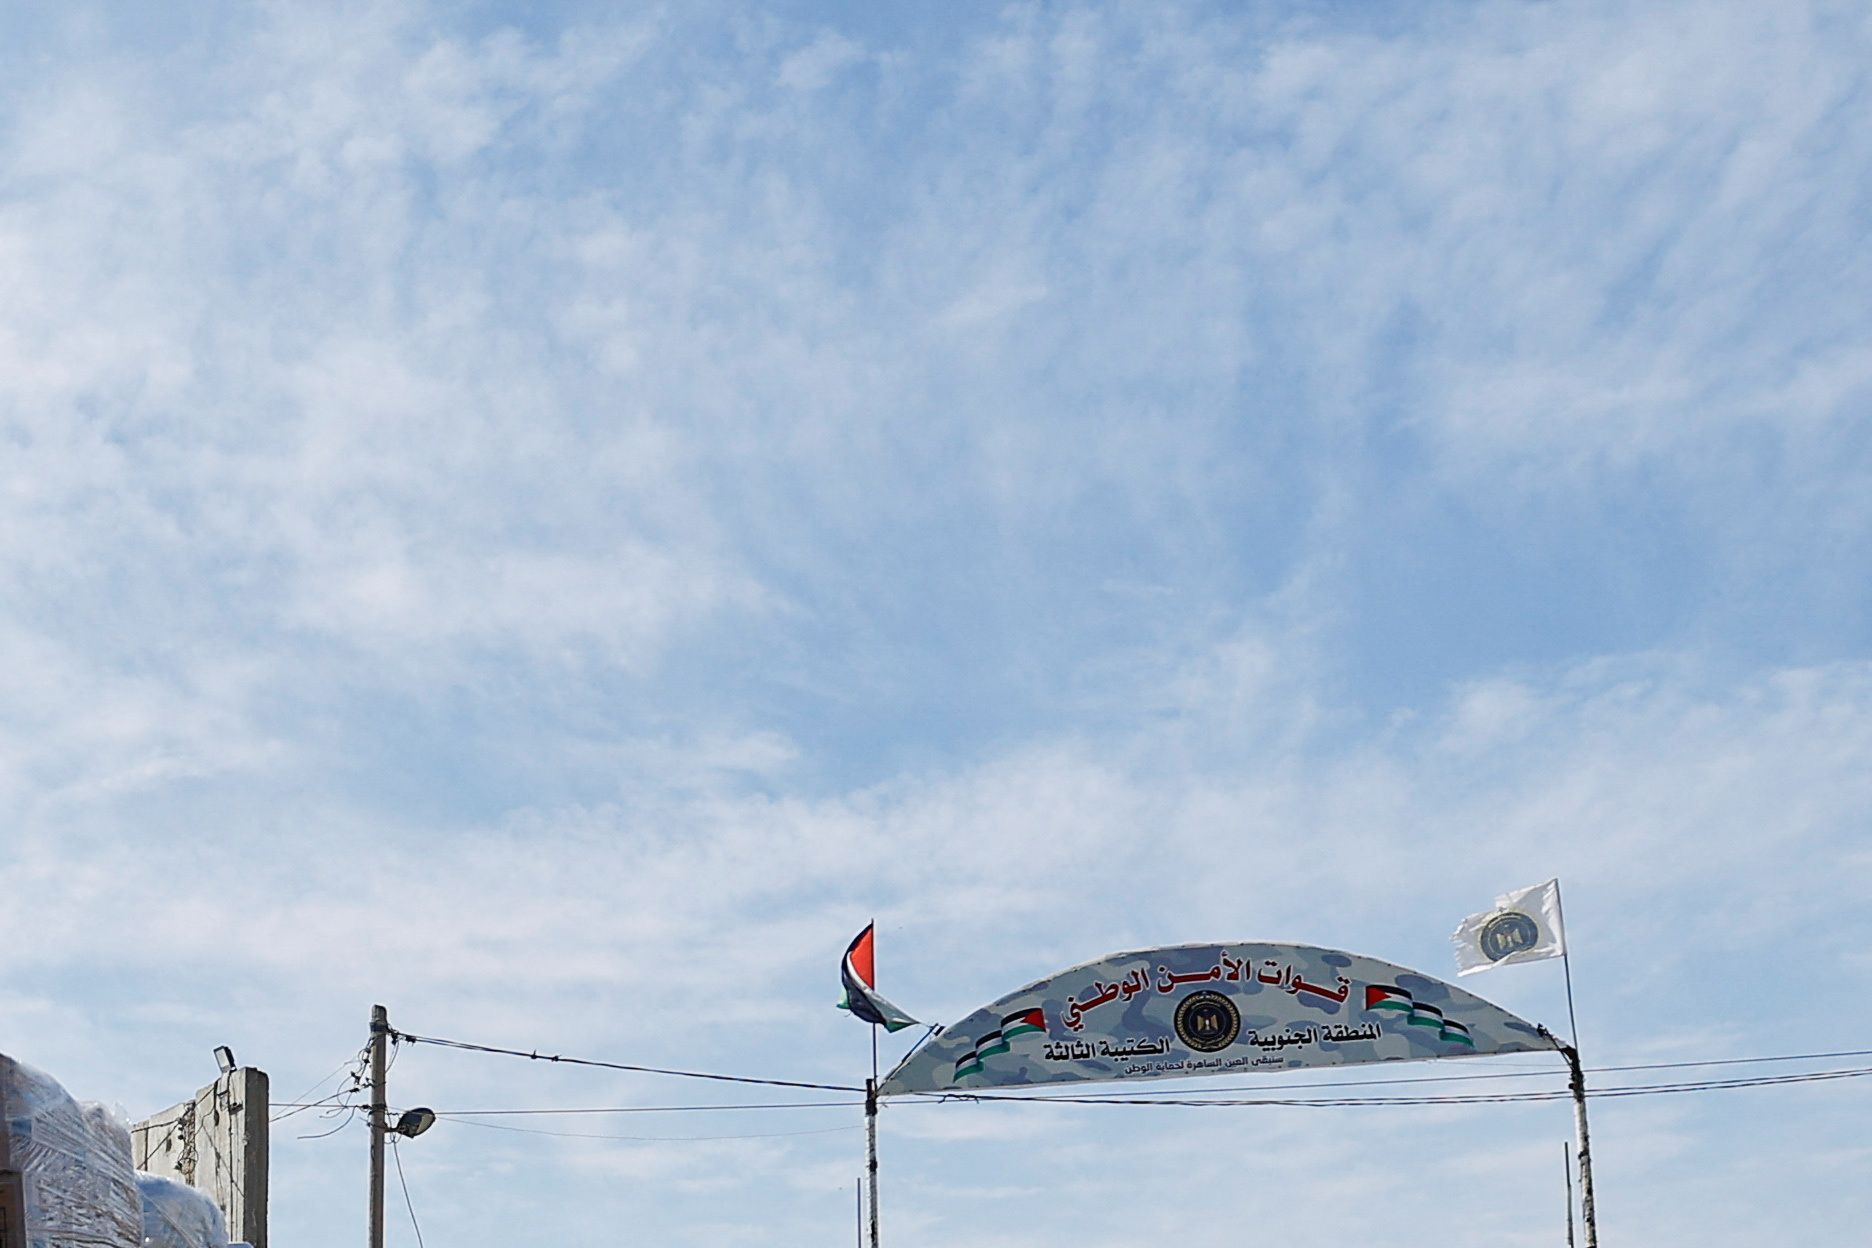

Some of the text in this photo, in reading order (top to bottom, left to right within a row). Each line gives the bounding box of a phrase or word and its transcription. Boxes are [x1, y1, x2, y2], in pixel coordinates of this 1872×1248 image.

[1062, 951, 1351, 1031] قوات الأمن الوطني
[1043, 1037, 1170, 1062] الكتيبة الثالثة
[1247, 1023, 1382, 1051] المنطقة الجنوبية
